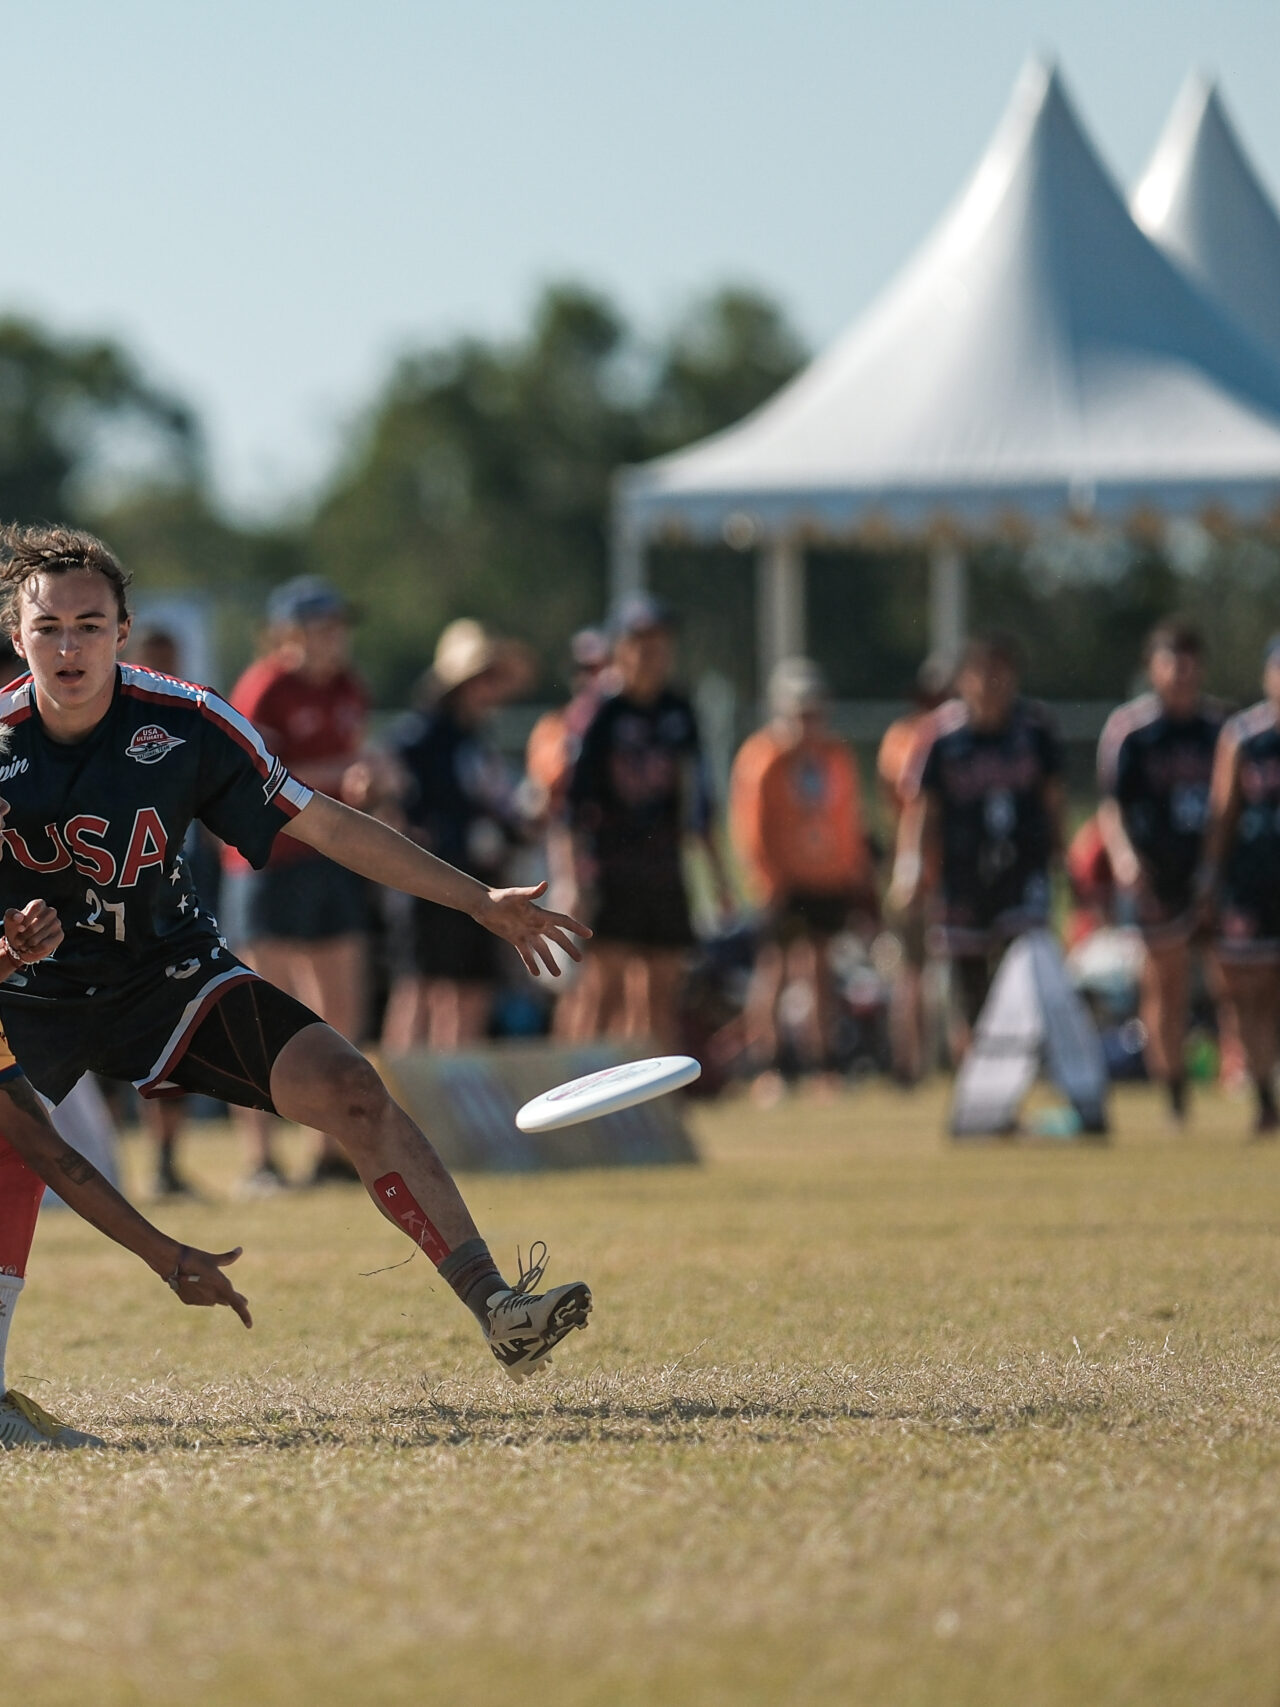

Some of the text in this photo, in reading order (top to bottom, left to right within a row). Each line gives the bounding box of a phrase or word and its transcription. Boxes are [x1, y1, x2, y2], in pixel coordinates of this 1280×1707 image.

[1, 807, 168, 888] USA
[76, 889, 125, 942] 27
[385, 1186, 397, 1198] KT
